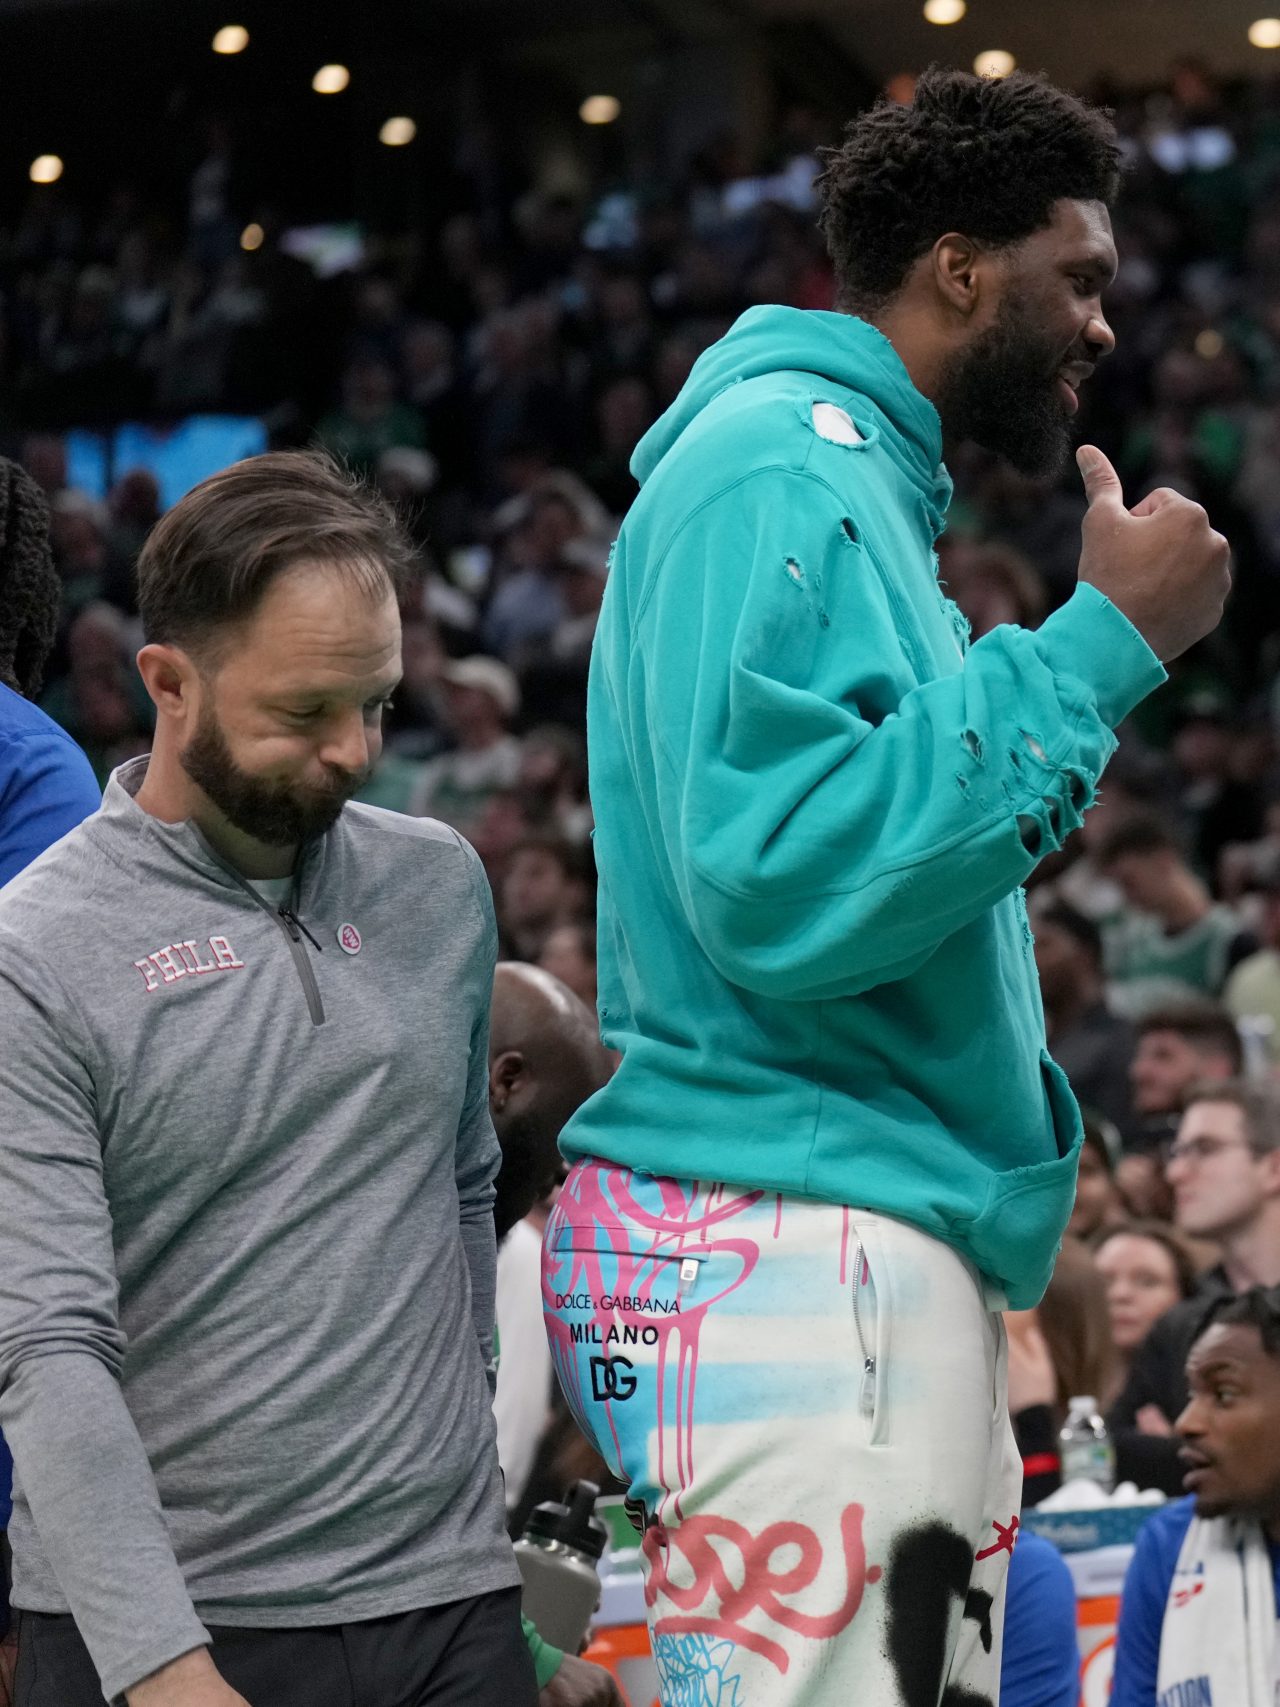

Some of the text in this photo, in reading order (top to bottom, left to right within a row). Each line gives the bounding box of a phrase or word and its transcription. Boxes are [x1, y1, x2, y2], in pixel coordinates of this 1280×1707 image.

[132, 936, 244, 992] PHILA
[556, 1294, 591, 1309] DOLCE
[600, 1295, 681, 1315] GABBANA
[570, 1323, 659, 1346] MILANO
[589, 1355, 638, 1402] DG
